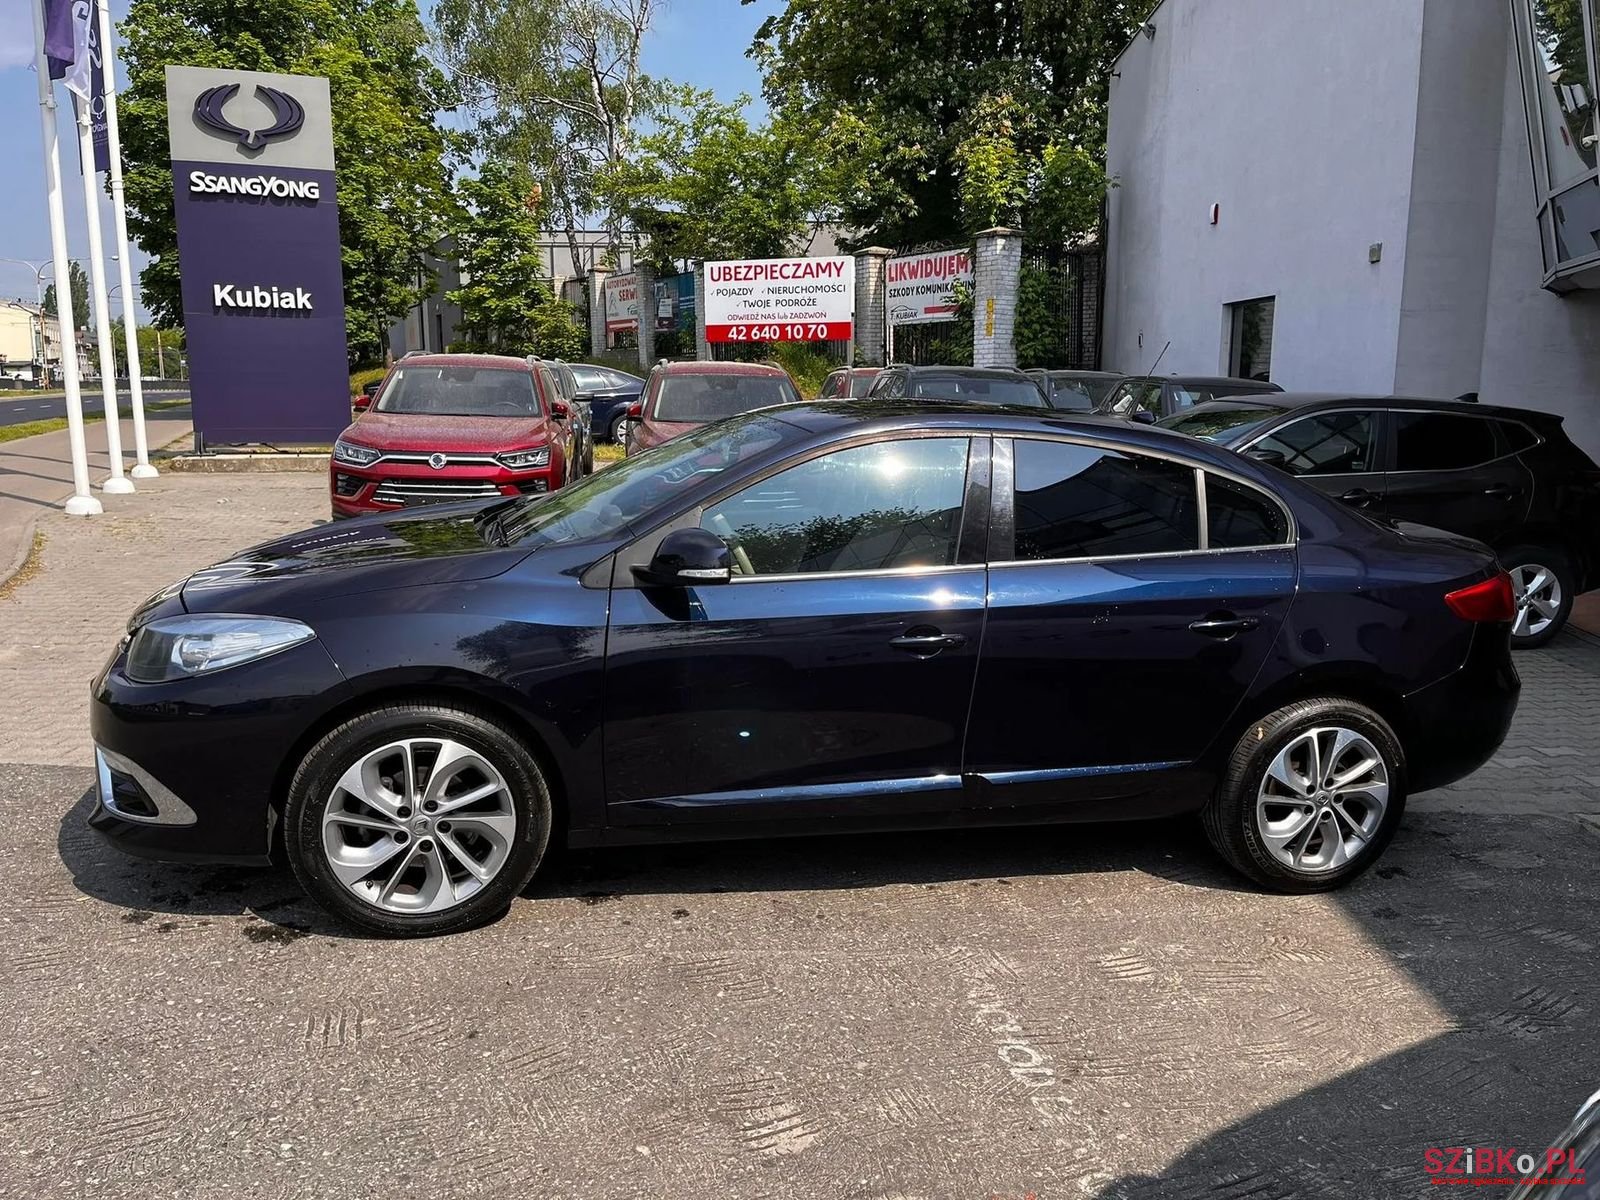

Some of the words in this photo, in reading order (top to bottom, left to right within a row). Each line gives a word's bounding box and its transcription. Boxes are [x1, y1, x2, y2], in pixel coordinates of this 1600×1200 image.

[710, 261, 845, 282] UBEZPIECZAMY
[716, 287, 754, 297] POJAZDY
[767, 283, 846, 295] NIERUCHOMOŚCI
[889, 286, 914, 298] SZKODY
[214, 284, 313, 310] Kubiak
[743, 299, 771, 308] TWOJE
[761, 312, 776, 320] NAS
[778, 312, 789, 320] lub
[896, 311, 917, 320] KUBIAK
[728, 327, 746, 340] 42
[751, 326, 780, 340] 640
[785, 325, 804, 338] 10
[808, 324, 828, 338] 70
